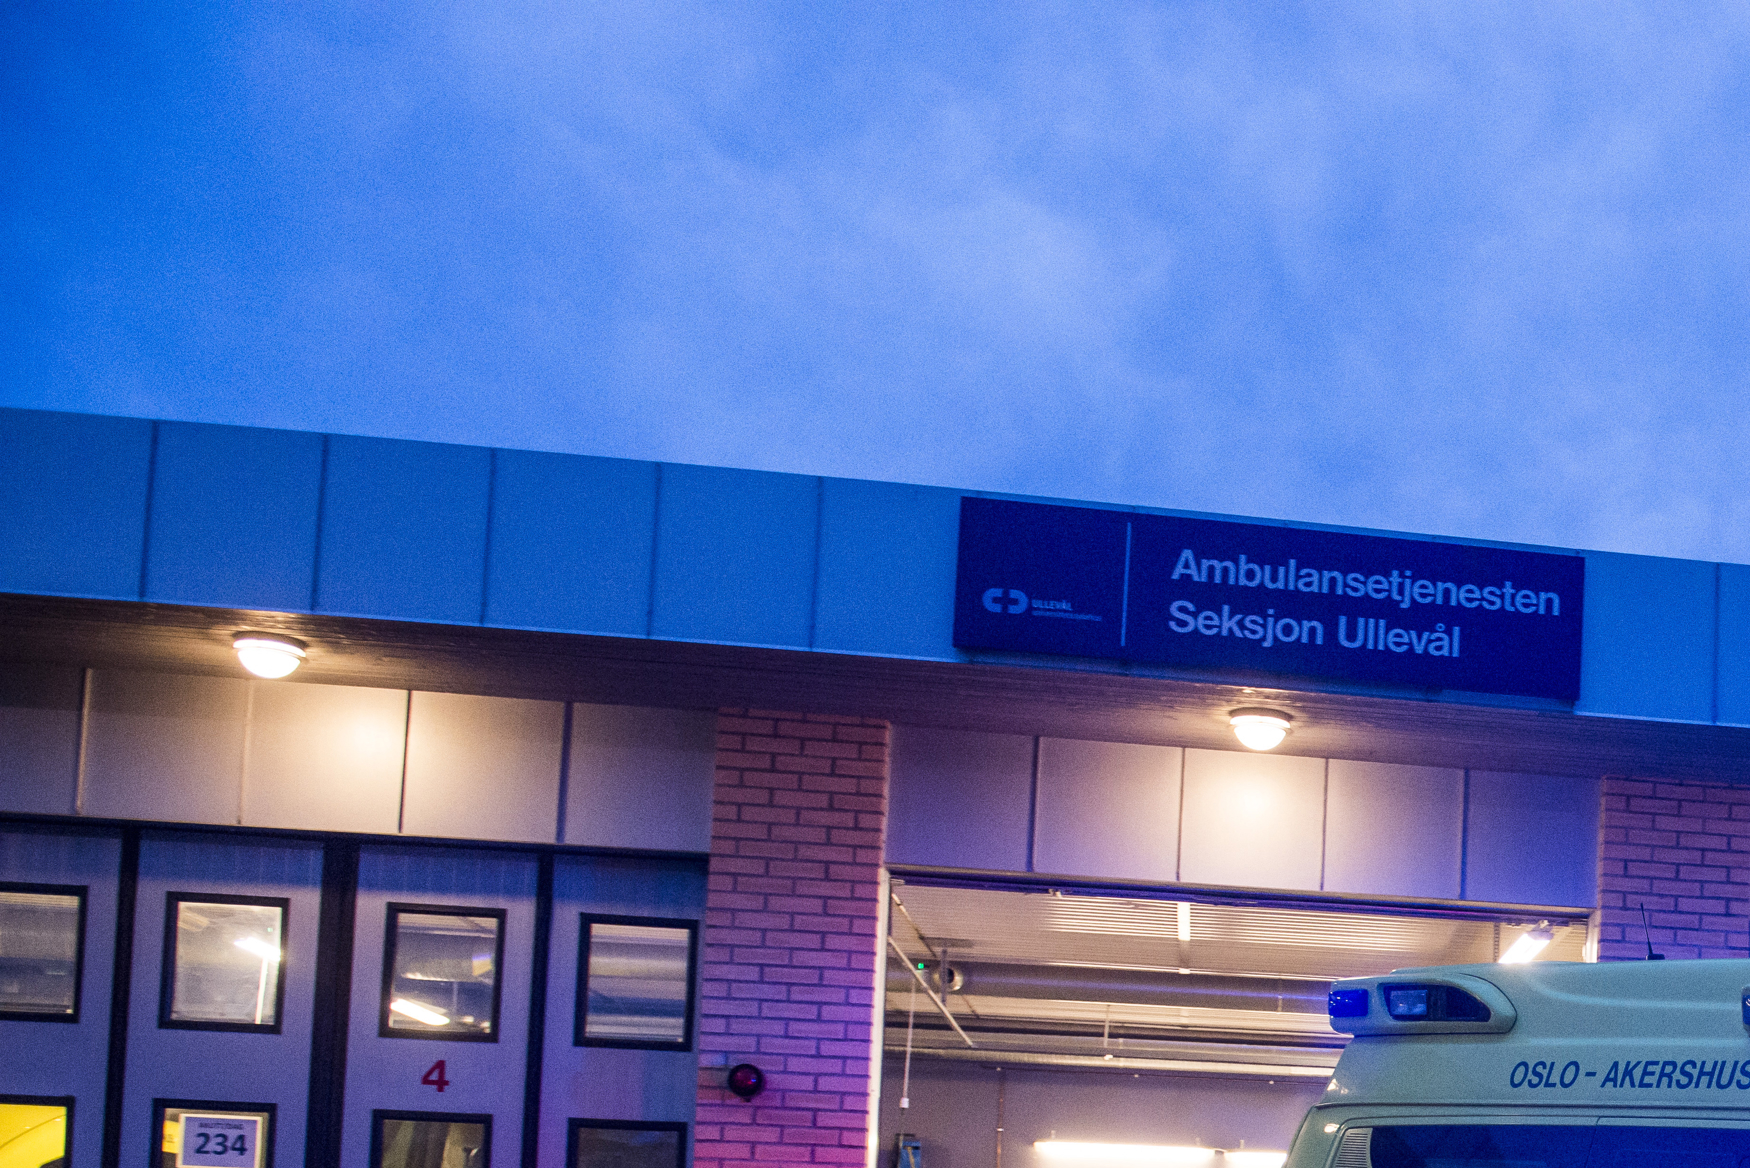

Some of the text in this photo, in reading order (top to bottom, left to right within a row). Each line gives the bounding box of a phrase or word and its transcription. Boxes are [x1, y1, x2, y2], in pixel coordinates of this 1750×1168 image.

[1171, 548, 1561, 616] Ambulansetjenesten
[1168, 600, 1461, 658] Seksjon Ullevål
[421, 1059, 450, 1093] 4
[194, 1132, 249, 1157] 234
